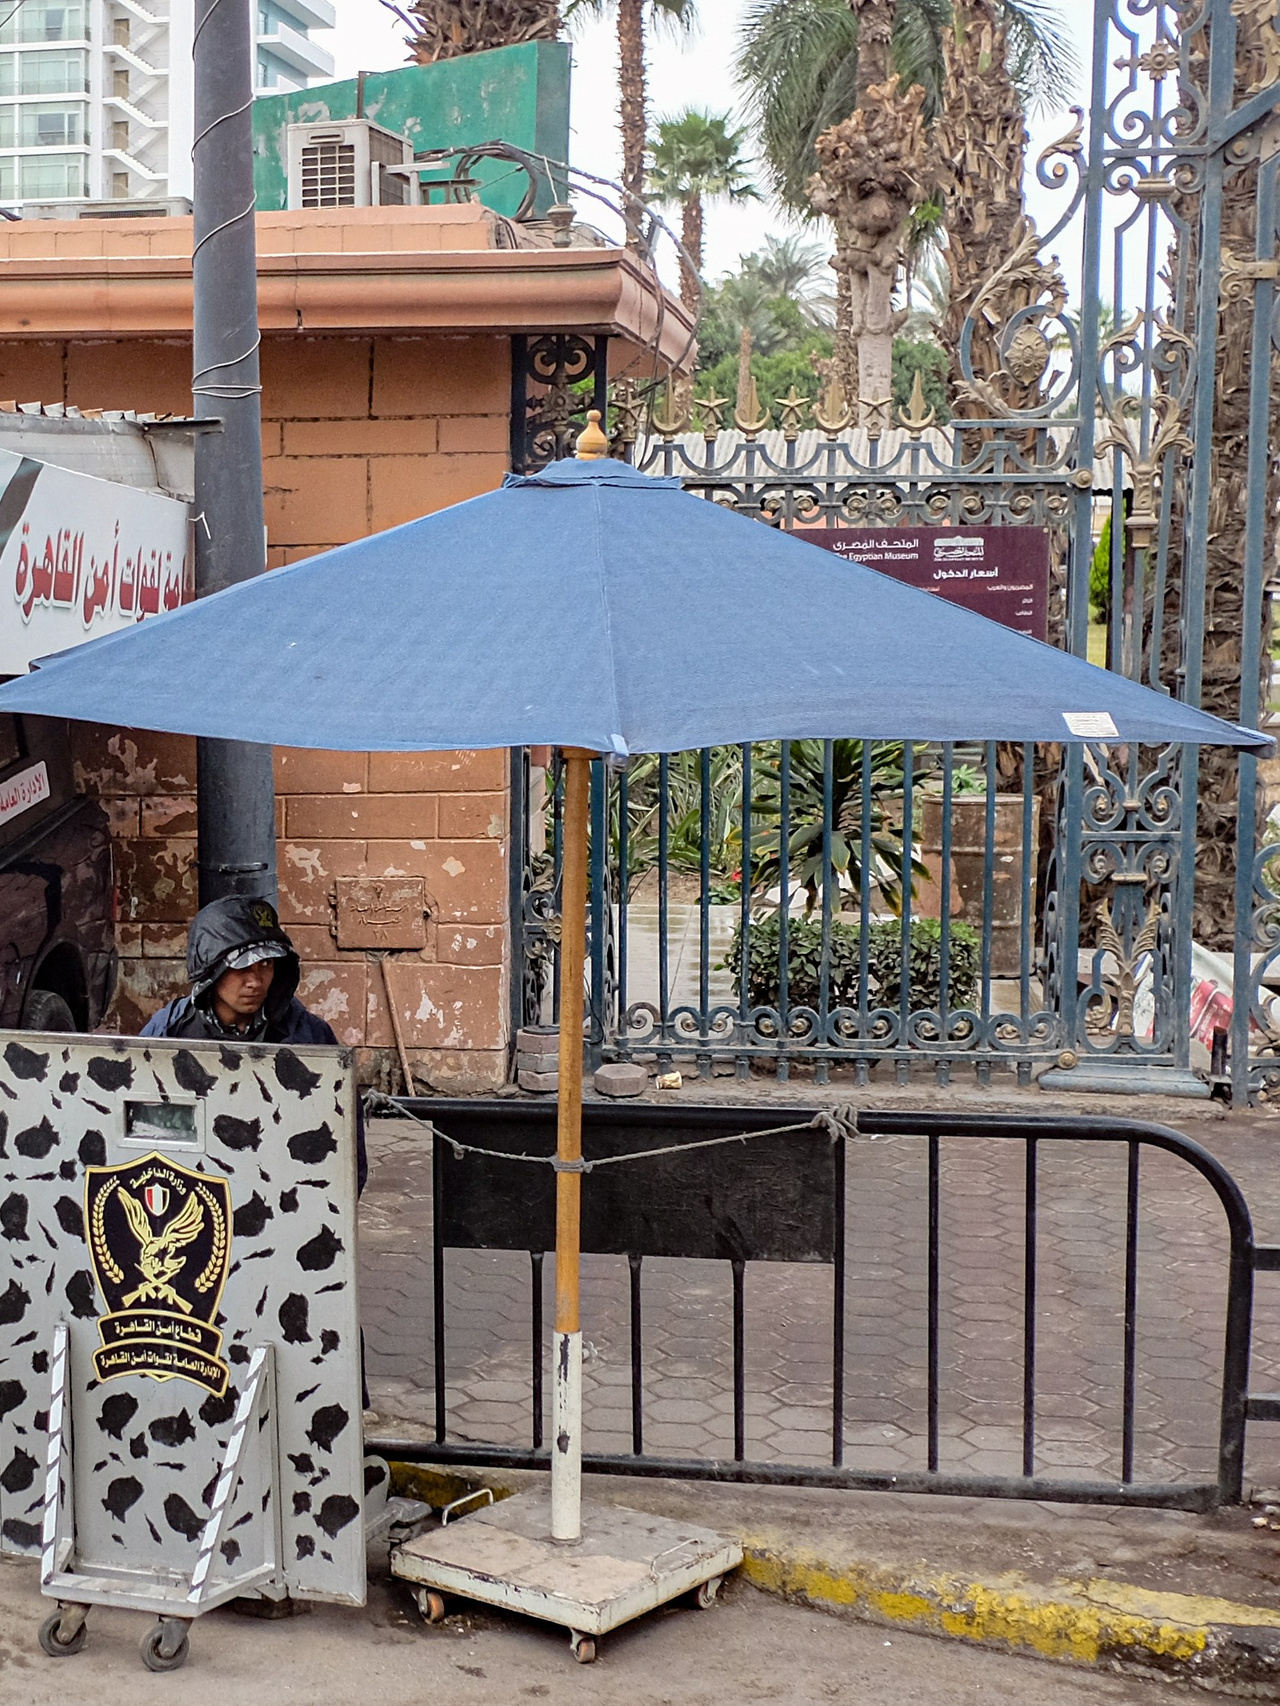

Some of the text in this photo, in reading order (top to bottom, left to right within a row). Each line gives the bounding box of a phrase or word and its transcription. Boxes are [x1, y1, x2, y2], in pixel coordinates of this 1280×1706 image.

[875, 538, 919, 549] المتحف
[848, 551, 883, 562] Egyptian
[884, 552, 919, 560] Museum
[15, 521, 85, 618] القاهرة
[83, 519, 119, 624] أمن
[933, 566, 999, 579] أسعار الدخول
[0, 787, 21, 811] العامة
[129, 1167, 187, 1195] وزارة الداخلية
[114, 1318, 202, 1343] قطاع أمن القاهرة
[100, 1350, 130, 1368] القاهرة
[131, 1349, 147, 1366] أمن
[147, 1350, 173, 1366] لقوات
[173, 1353, 200, 1371] العامة
